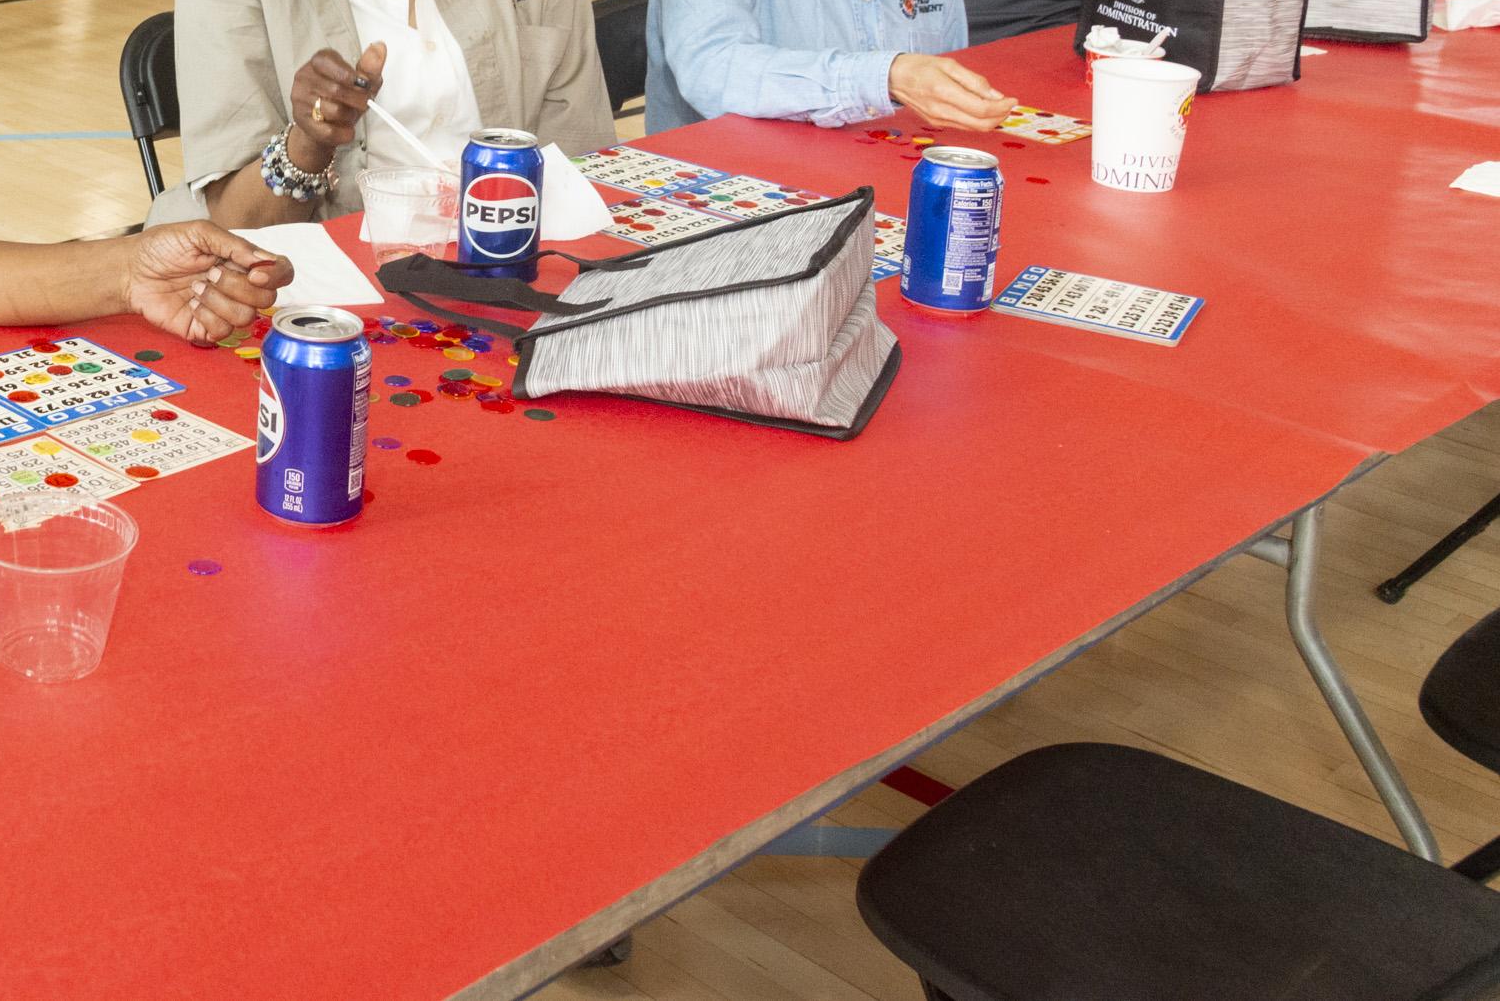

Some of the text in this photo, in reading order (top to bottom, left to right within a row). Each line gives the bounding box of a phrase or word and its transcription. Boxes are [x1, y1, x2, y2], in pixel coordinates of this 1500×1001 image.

[1114, 1, 1157, 21] DIVISION OF
[466, 201, 536, 224] PEPSI
[1000, 267, 1047, 304] BINGO
[1042, 277, 1060, 286] 56
[1035, 284, 1053, 293] 45
[1026, 292, 1044, 302] 20
[1065, 291, 1083, 299] 43
[1057, 299, 1076, 307] 17
[1089, 305, 1109, 314] 28
[1122, 312, 1142, 321] 25
[1149, 295, 1191, 335] 15 23 39 47 66
[1117, 320, 1136, 328] 11
[14, 351, 36, 359] 31
[29, 360, 51, 369] 32
[4, 366, 28, 375] 59
[41, 373, 118, 395] 26 36 56
[115, 382, 137, 392] 27
[86, 390, 110, 398] 42
[47, 383, 174, 421] BINGO
[61, 397, 84, 407] 49
[33, 404, 60, 414] 73
[288, 472, 300, 481] 150
[290, 495, 295, 503] FL
